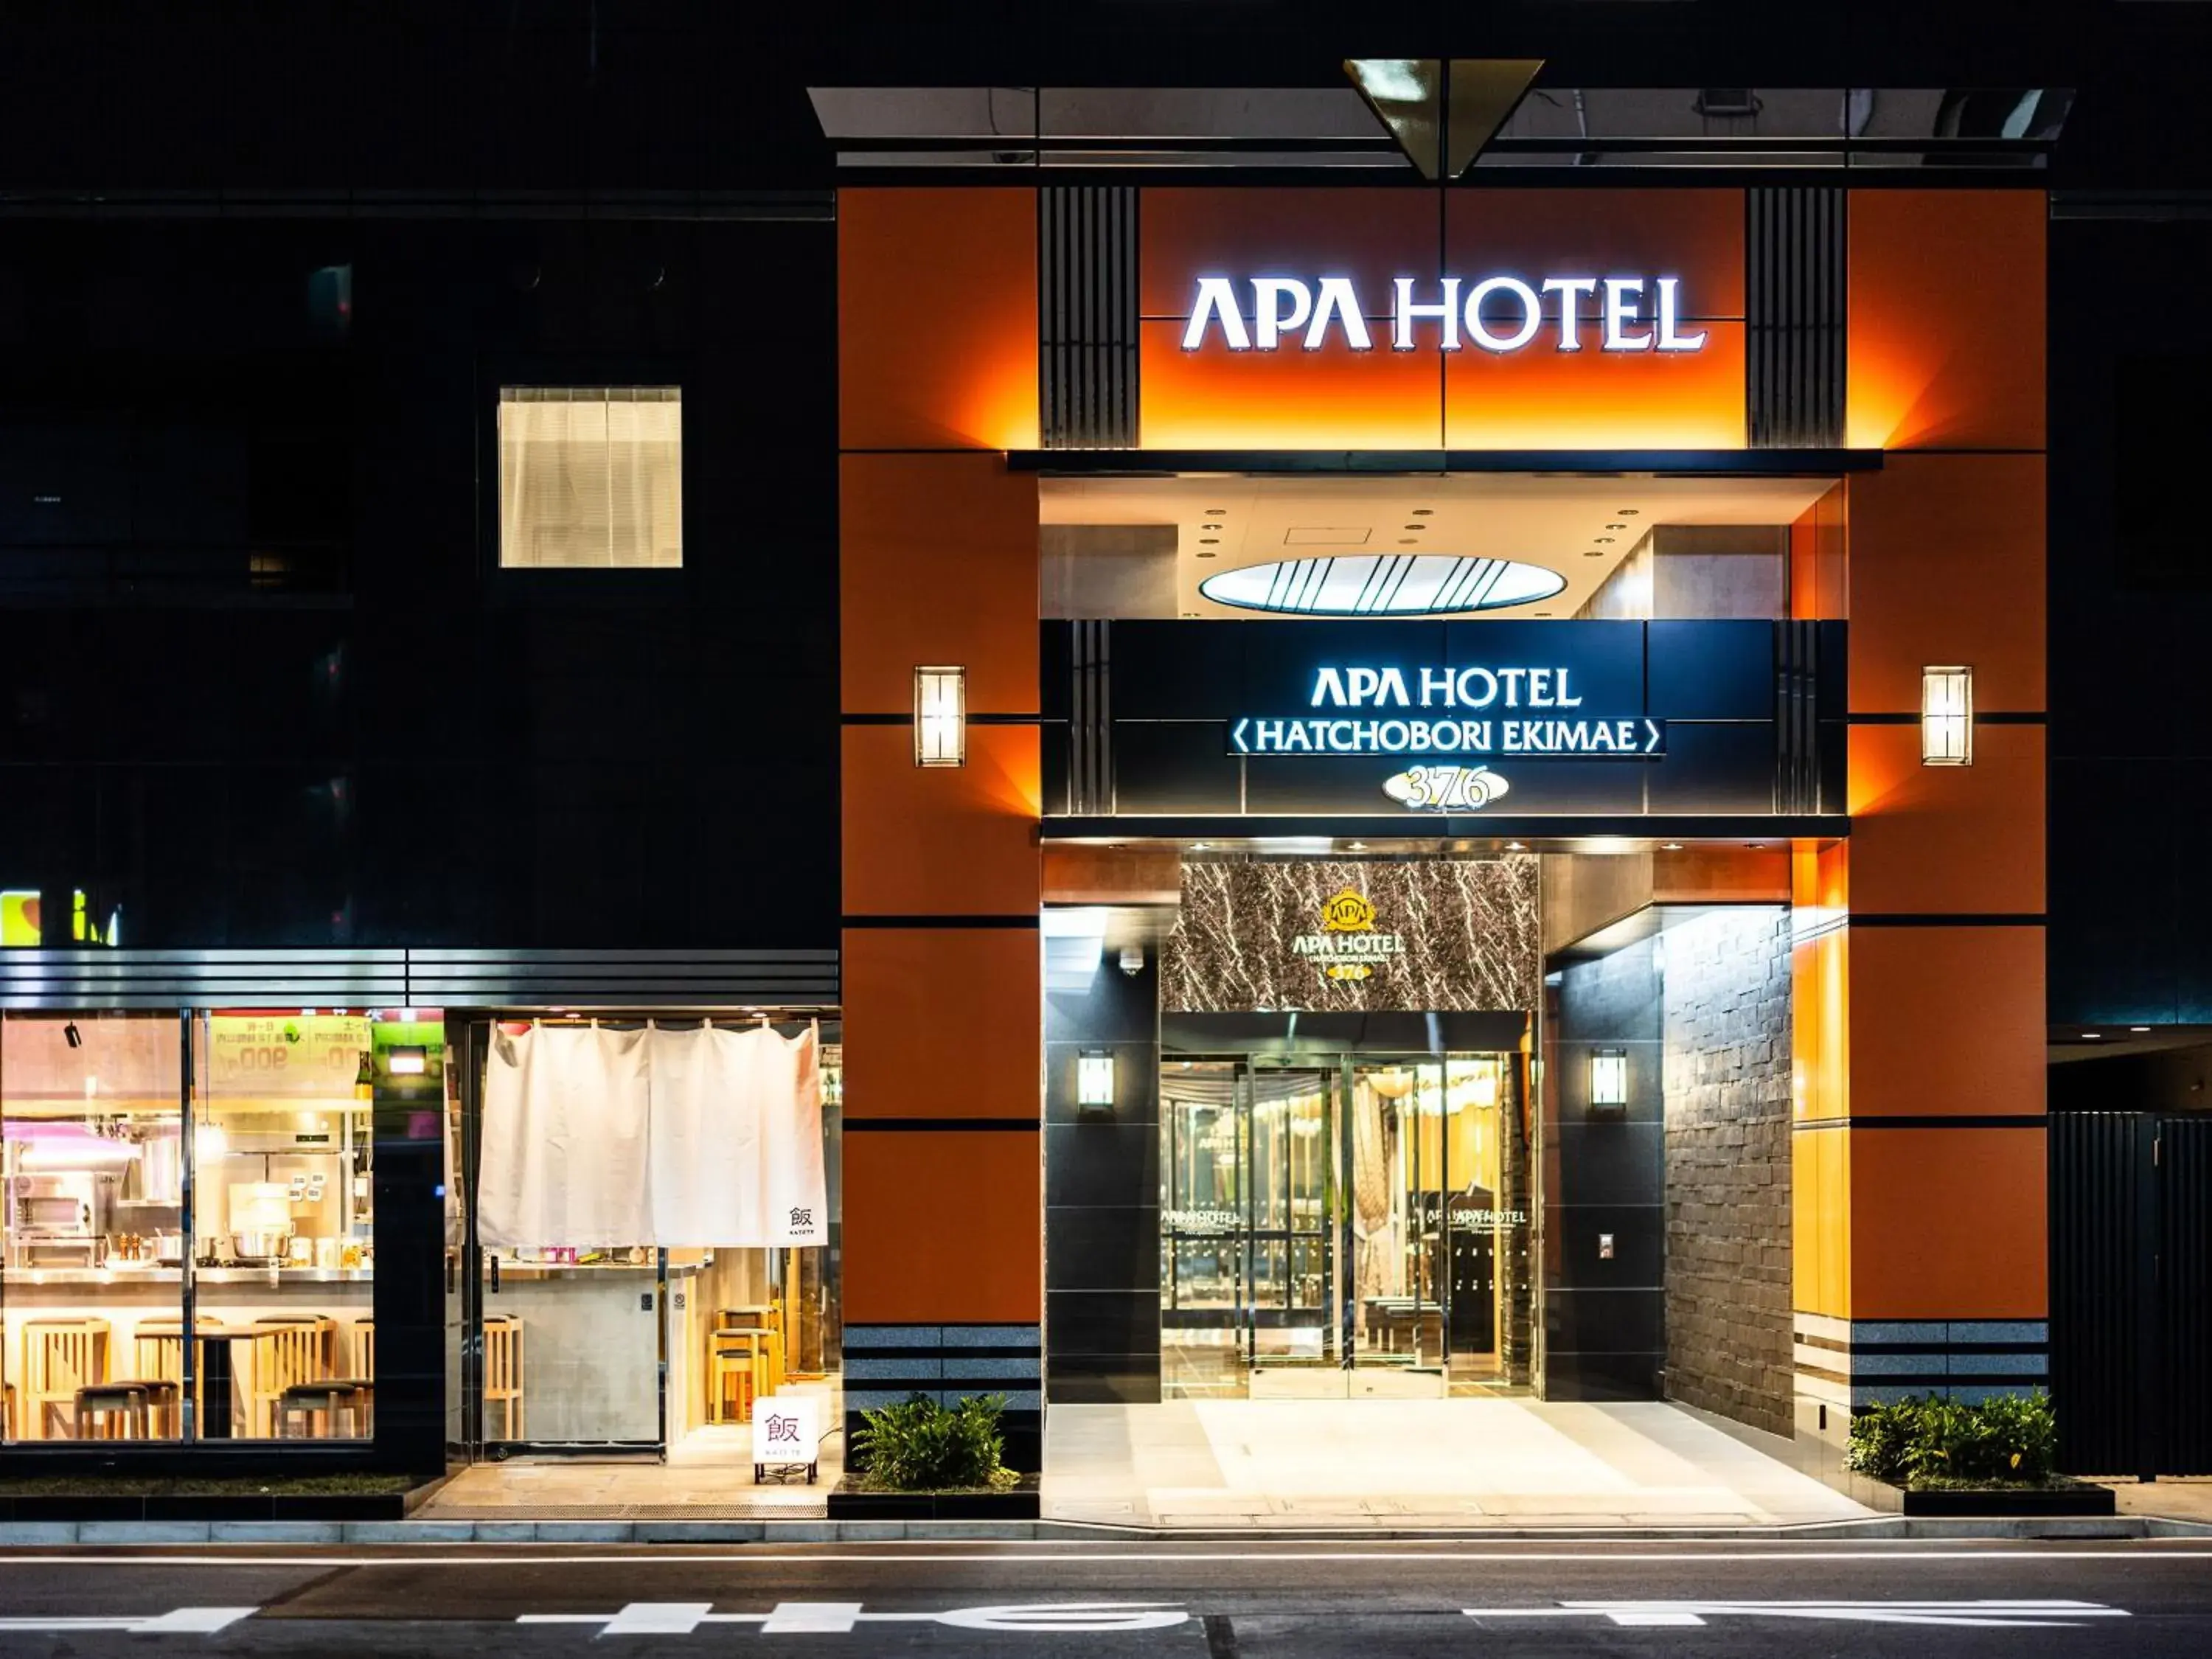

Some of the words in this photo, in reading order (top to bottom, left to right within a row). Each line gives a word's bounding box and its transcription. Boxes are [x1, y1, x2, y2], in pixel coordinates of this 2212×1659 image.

[1180, 276, 1374, 352] APA
[1391, 276, 1708, 353] HOTEL
[1310, 667, 1410, 707] APA
[1420, 667, 1583, 708] HOTEL
[1405, 764, 1491, 808] 376
[1332, 904, 1367, 919] APA
[1293, 934, 1336, 954] APA
[1338, 934, 1406, 954] HOTEL
[1333, 964, 1365, 980] 376
[790, 1207, 813, 1225] 飯
[765, 1413, 800, 1441] 飯
